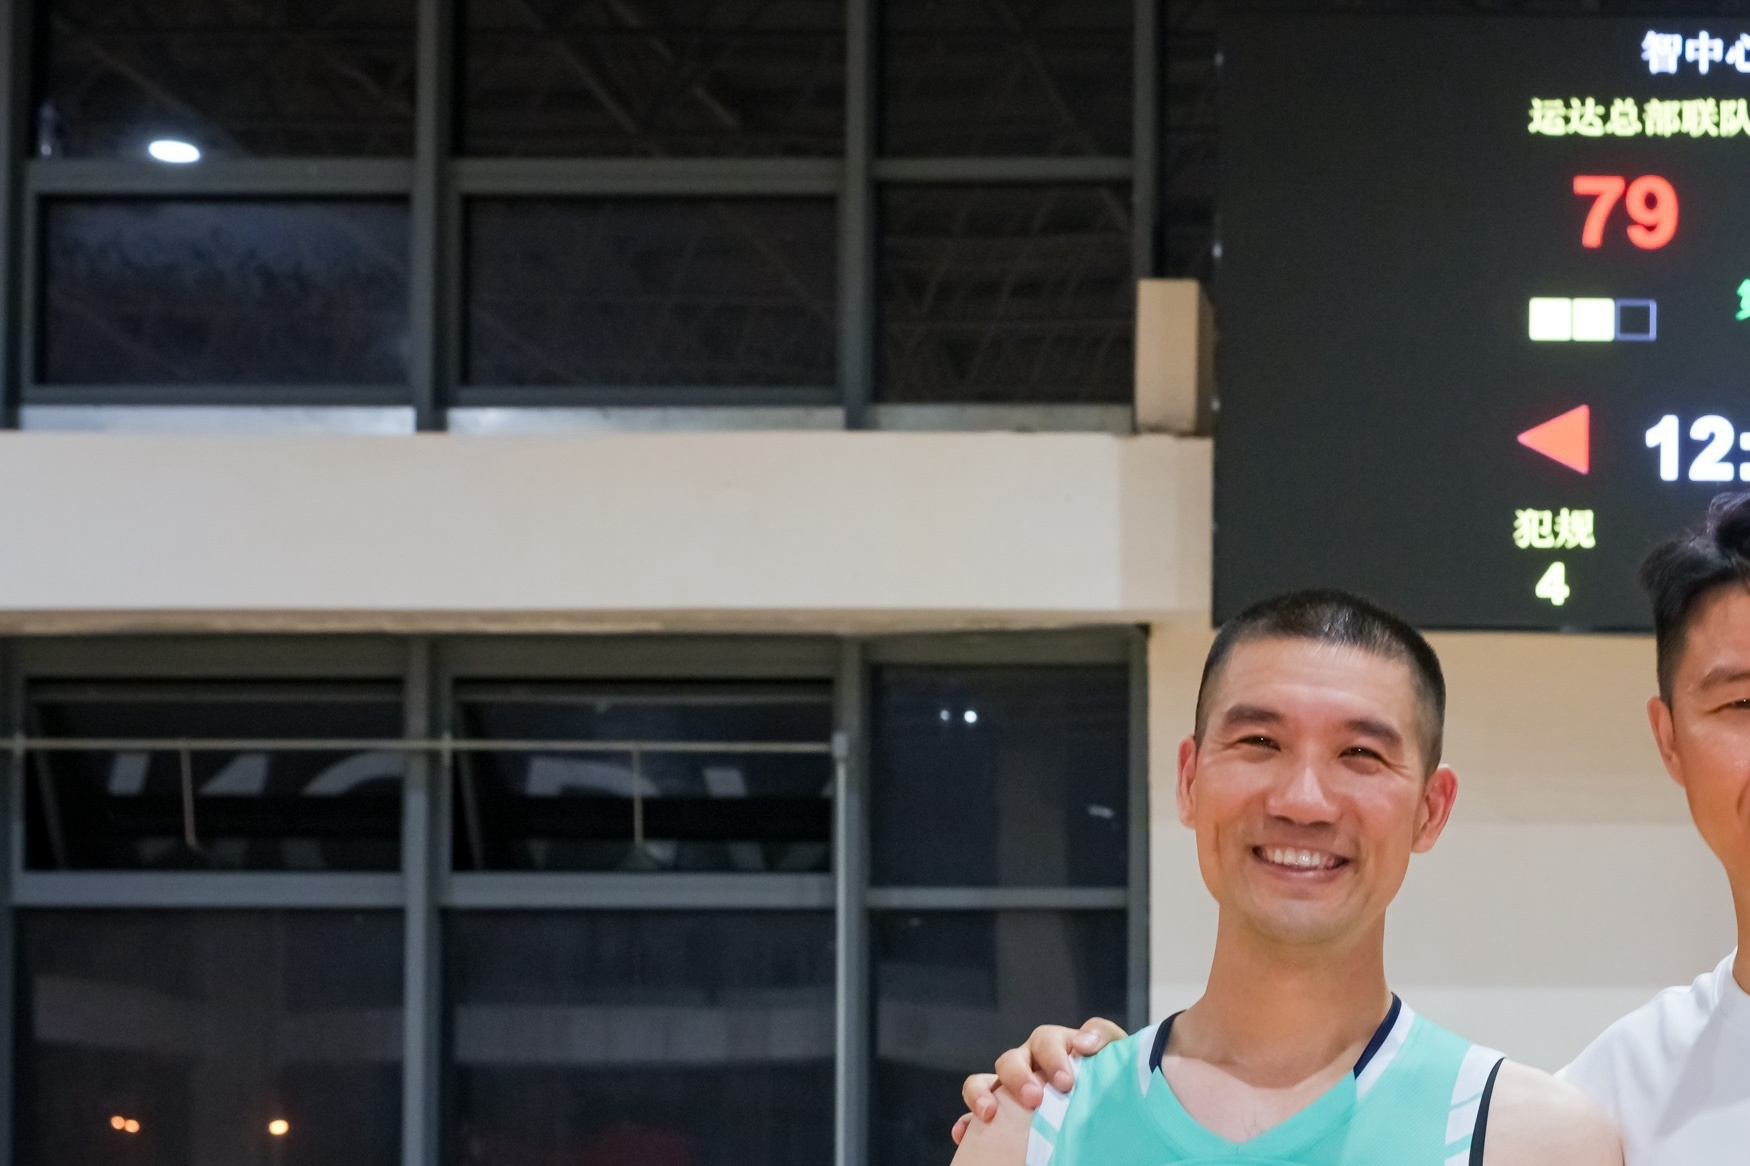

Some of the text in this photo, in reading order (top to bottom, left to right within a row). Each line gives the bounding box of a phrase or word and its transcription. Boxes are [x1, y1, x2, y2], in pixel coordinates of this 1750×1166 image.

[1573, 174, 1679, 250] 79
[1513, 508, 1596, 550] 犯规
[1535, 561, 1571, 606] 4
